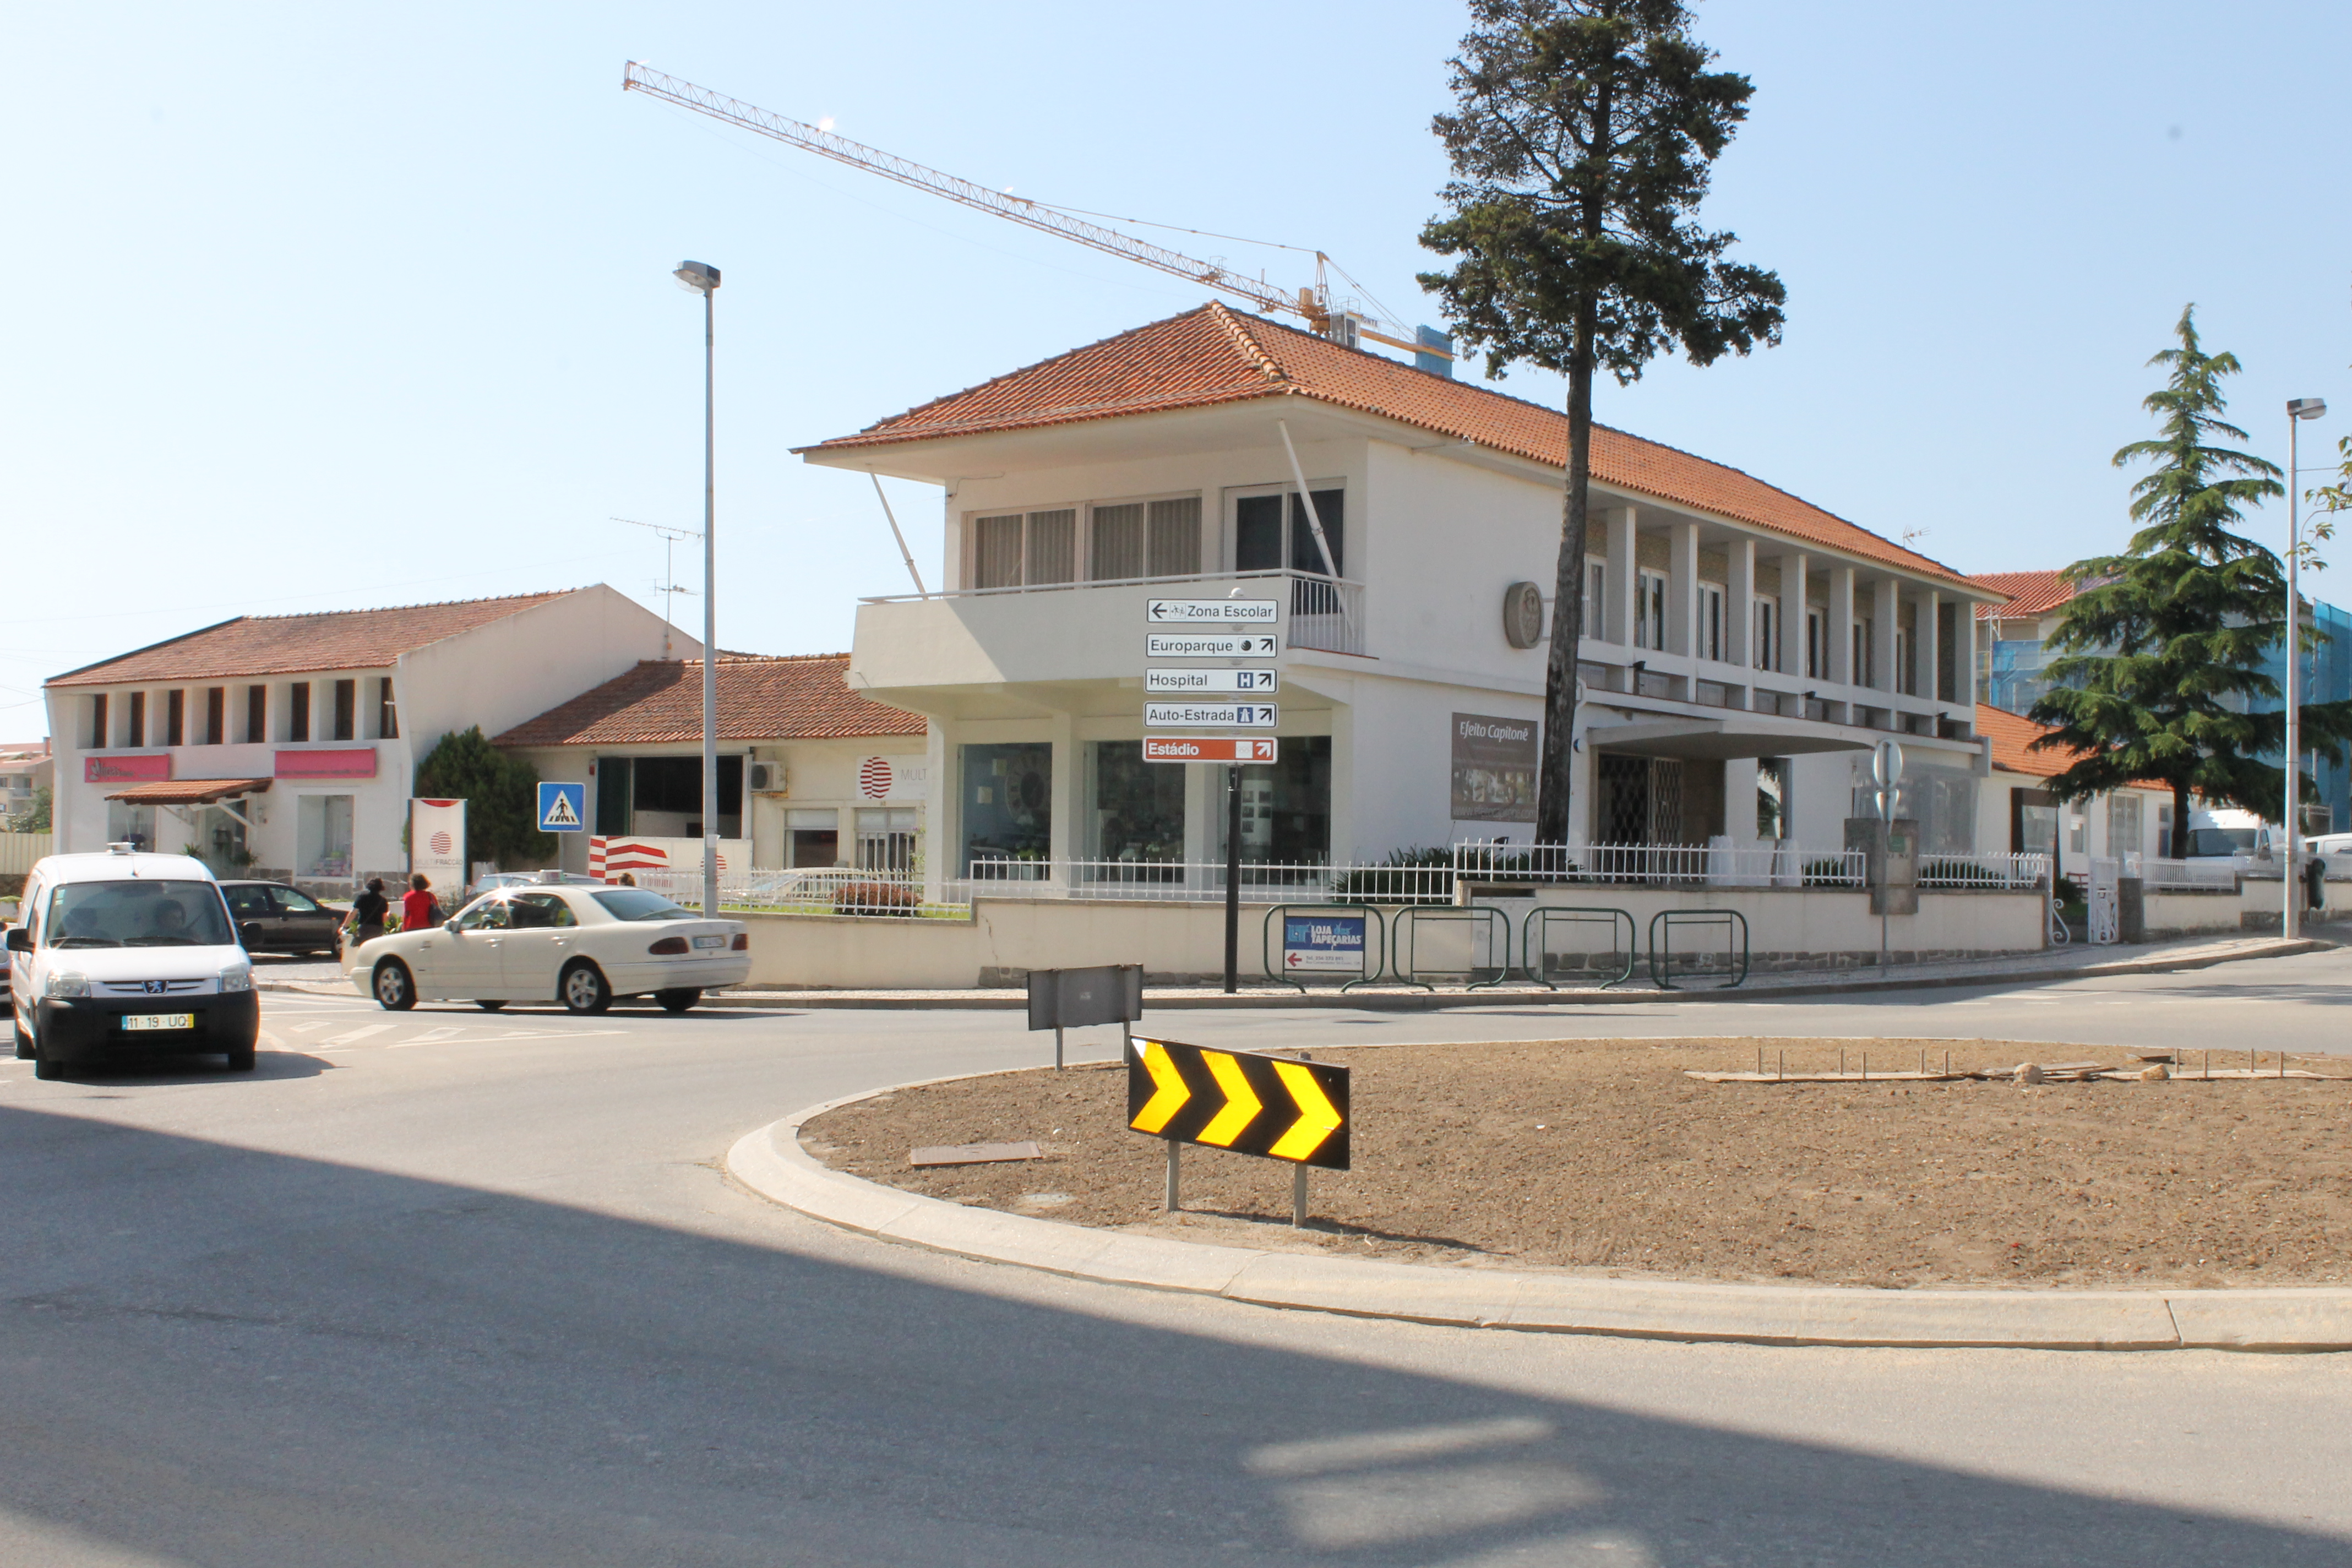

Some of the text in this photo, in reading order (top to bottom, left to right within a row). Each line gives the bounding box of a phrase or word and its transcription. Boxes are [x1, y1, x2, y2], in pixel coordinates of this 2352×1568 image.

[1188, 606, 1273, 618] Zona Escolar
[1151, 640, 1233, 654] Europarque
[1150, 674, 1207, 688] Hospital
[1149, 709, 1234, 721] Auto-Estrada
[1460, 721, 1487, 739] Efeito
[1148, 742, 1200, 756] Estádio
[1311, 925, 1332, 935] LOJA
[1311, 935, 1362, 946] TAPEÇARIAS
